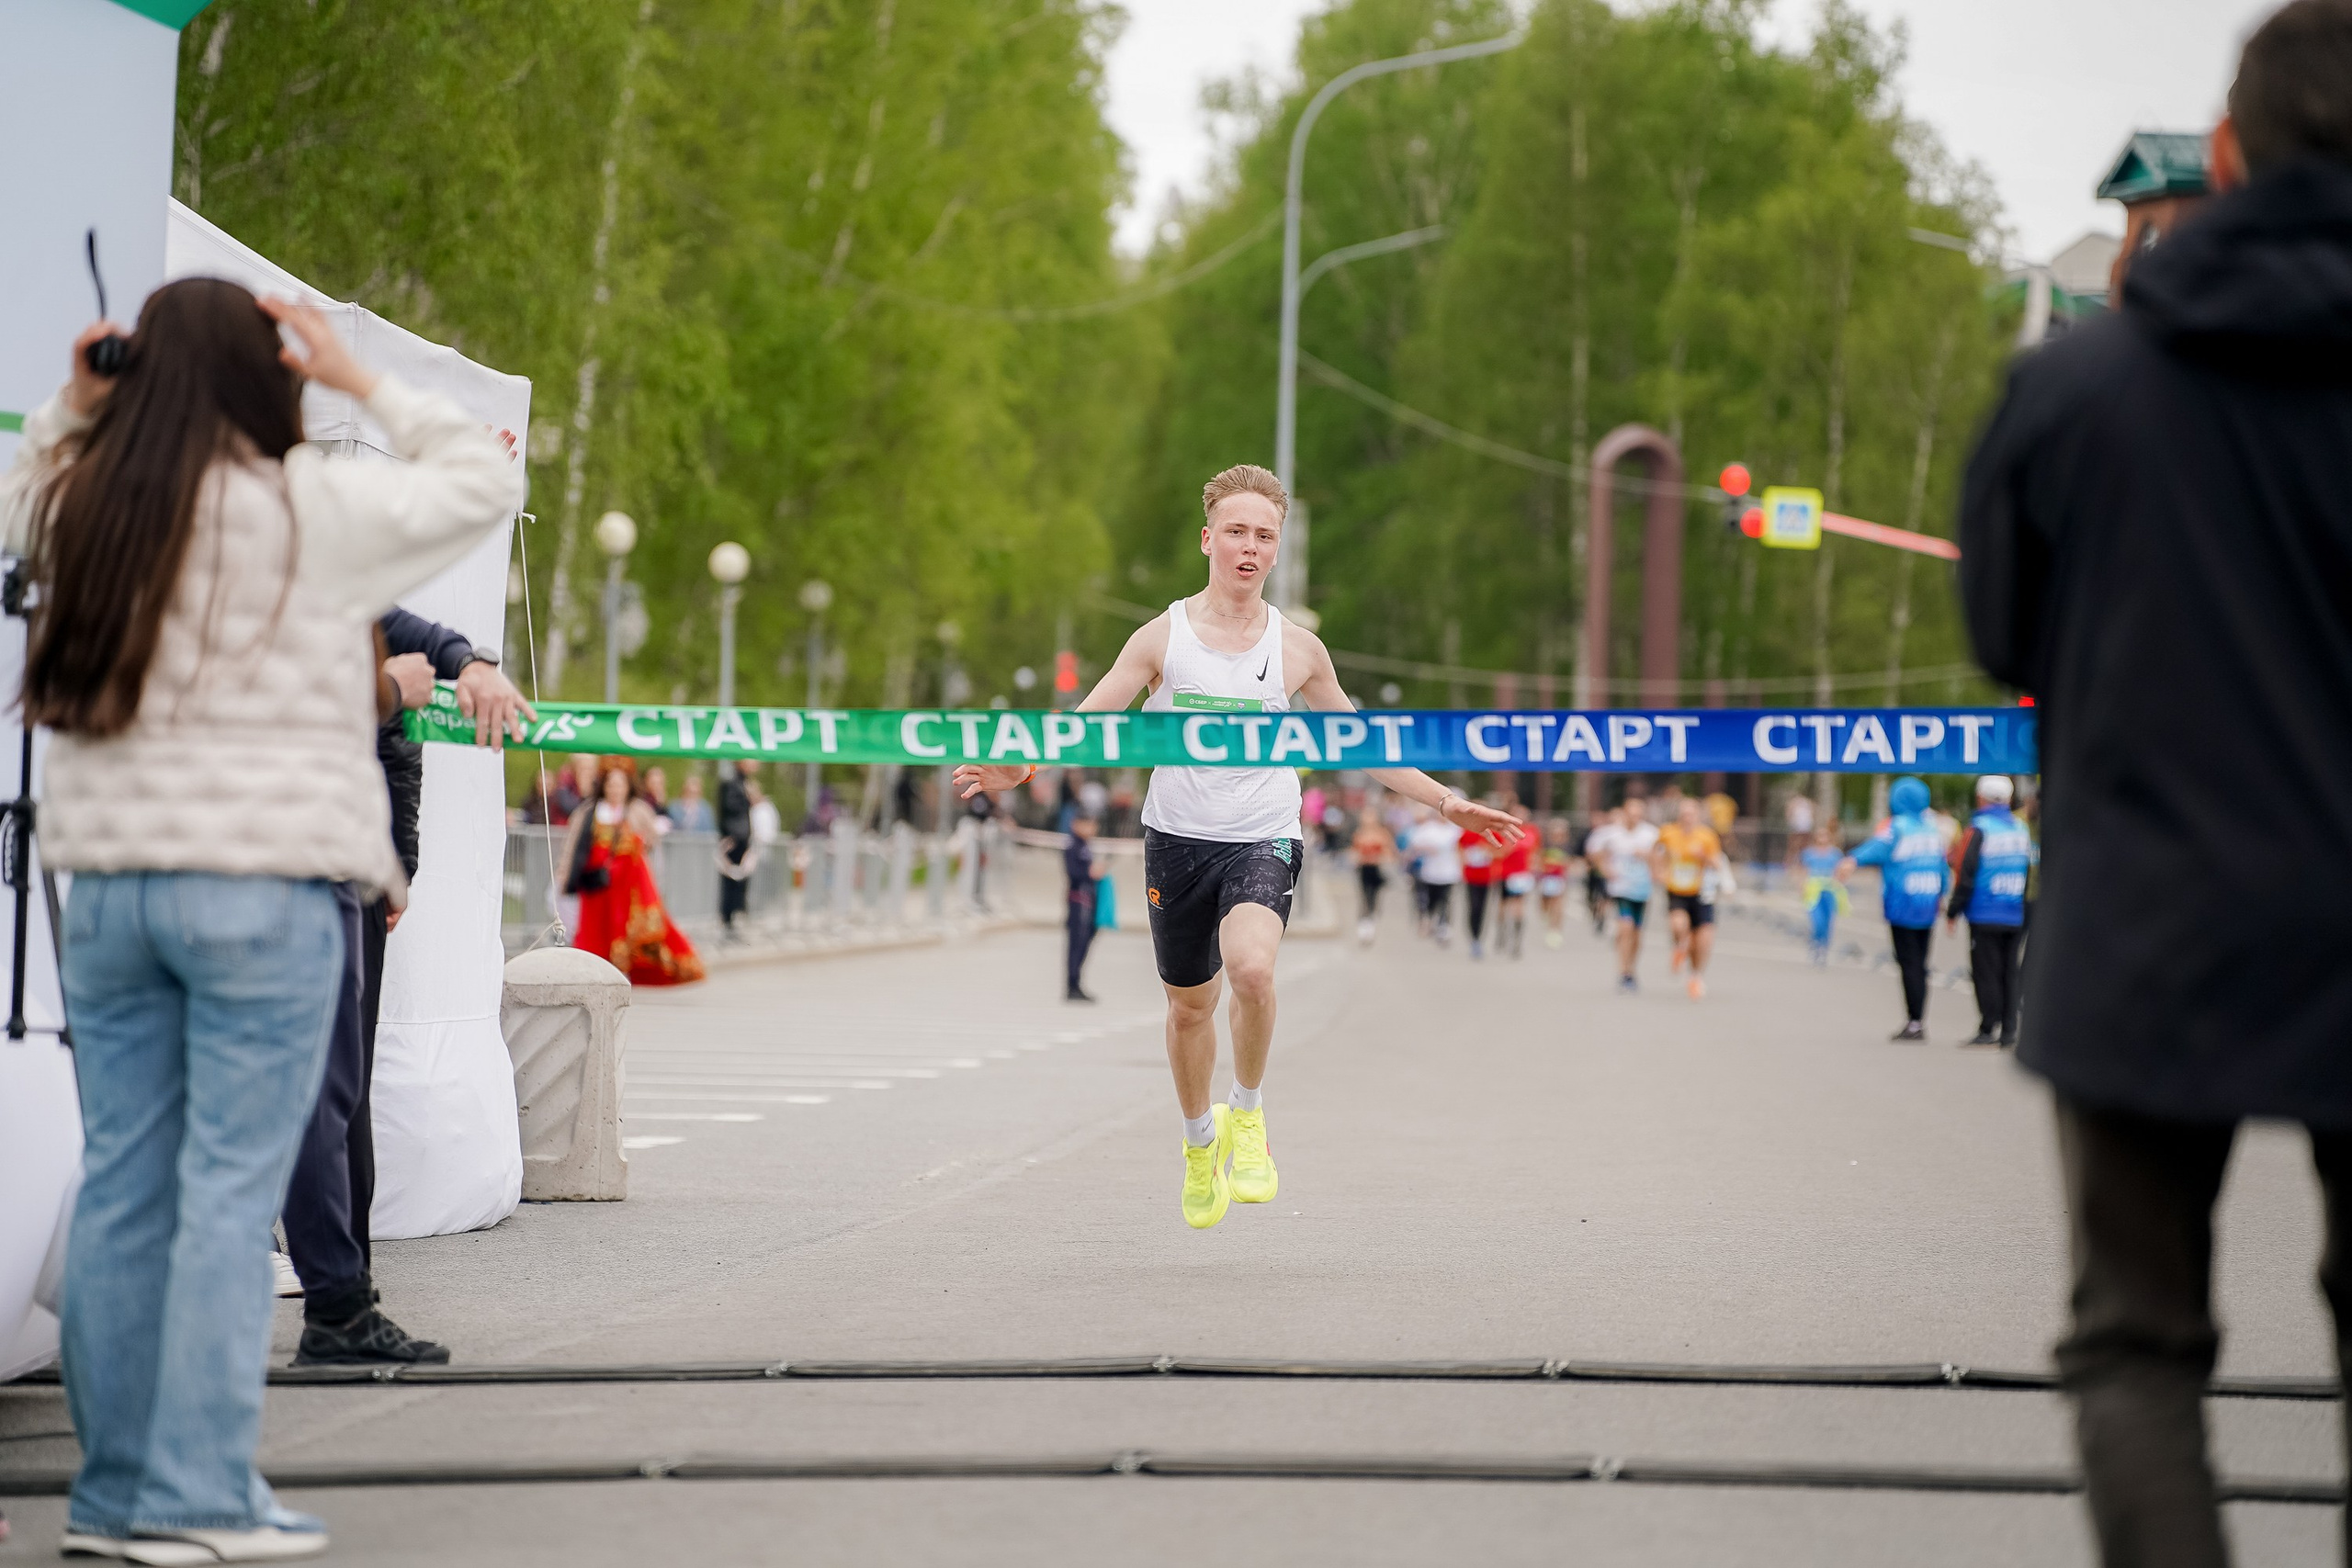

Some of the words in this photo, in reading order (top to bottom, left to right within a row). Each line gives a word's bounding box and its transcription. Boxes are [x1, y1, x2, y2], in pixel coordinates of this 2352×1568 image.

[616, 708, 849, 753] СТАРТ
[900, 713, 1129, 761] СТАРТ
[1182, 716, 1414, 761] СТАРТ
[1465, 716, 1700, 762] СТАРТ
[1753, 716, 1994, 763] СТАРТ
